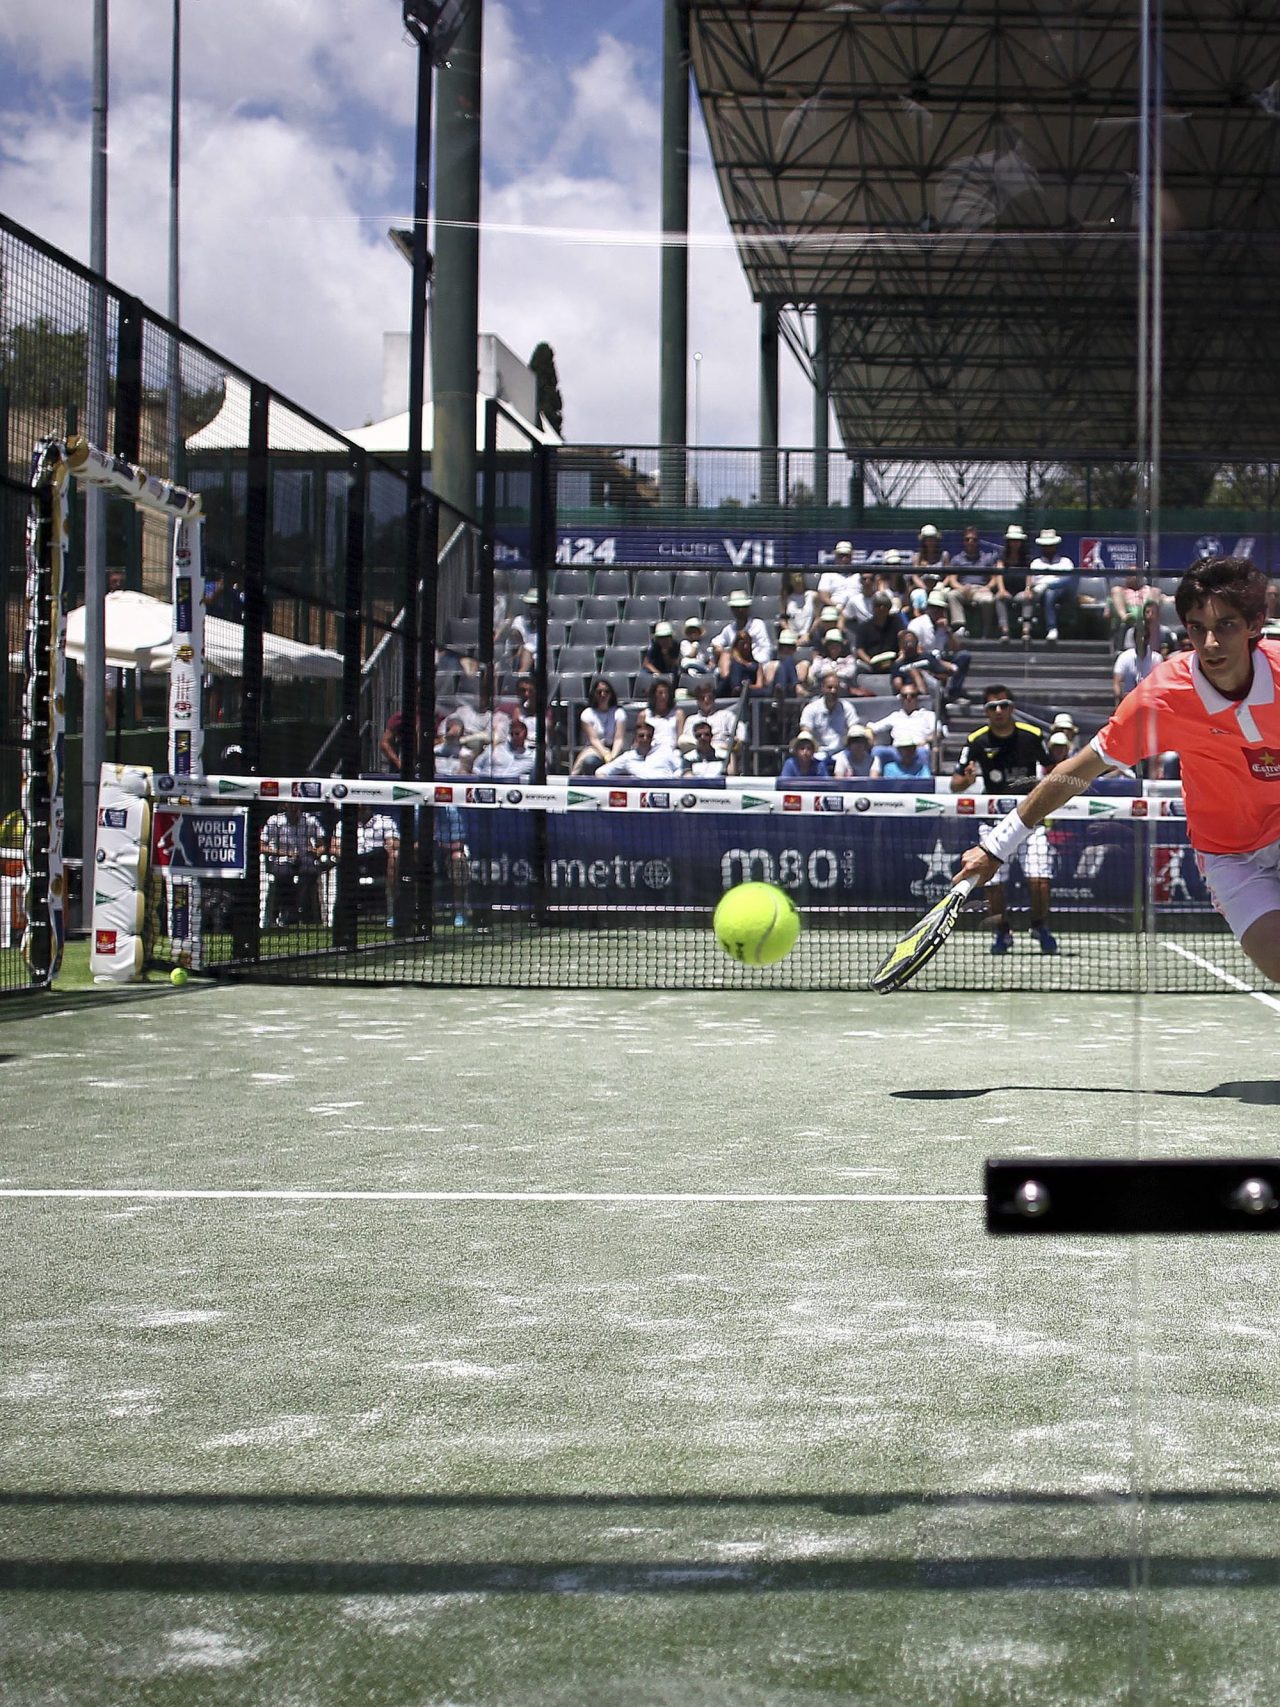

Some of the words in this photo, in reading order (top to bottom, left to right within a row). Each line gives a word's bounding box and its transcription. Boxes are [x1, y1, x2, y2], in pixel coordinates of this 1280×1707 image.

[192, 820, 236, 835] WORLD
[198, 834, 237, 849] PADEL
[202, 848, 236, 863] TOUR
[721, 848, 838, 889] m80
